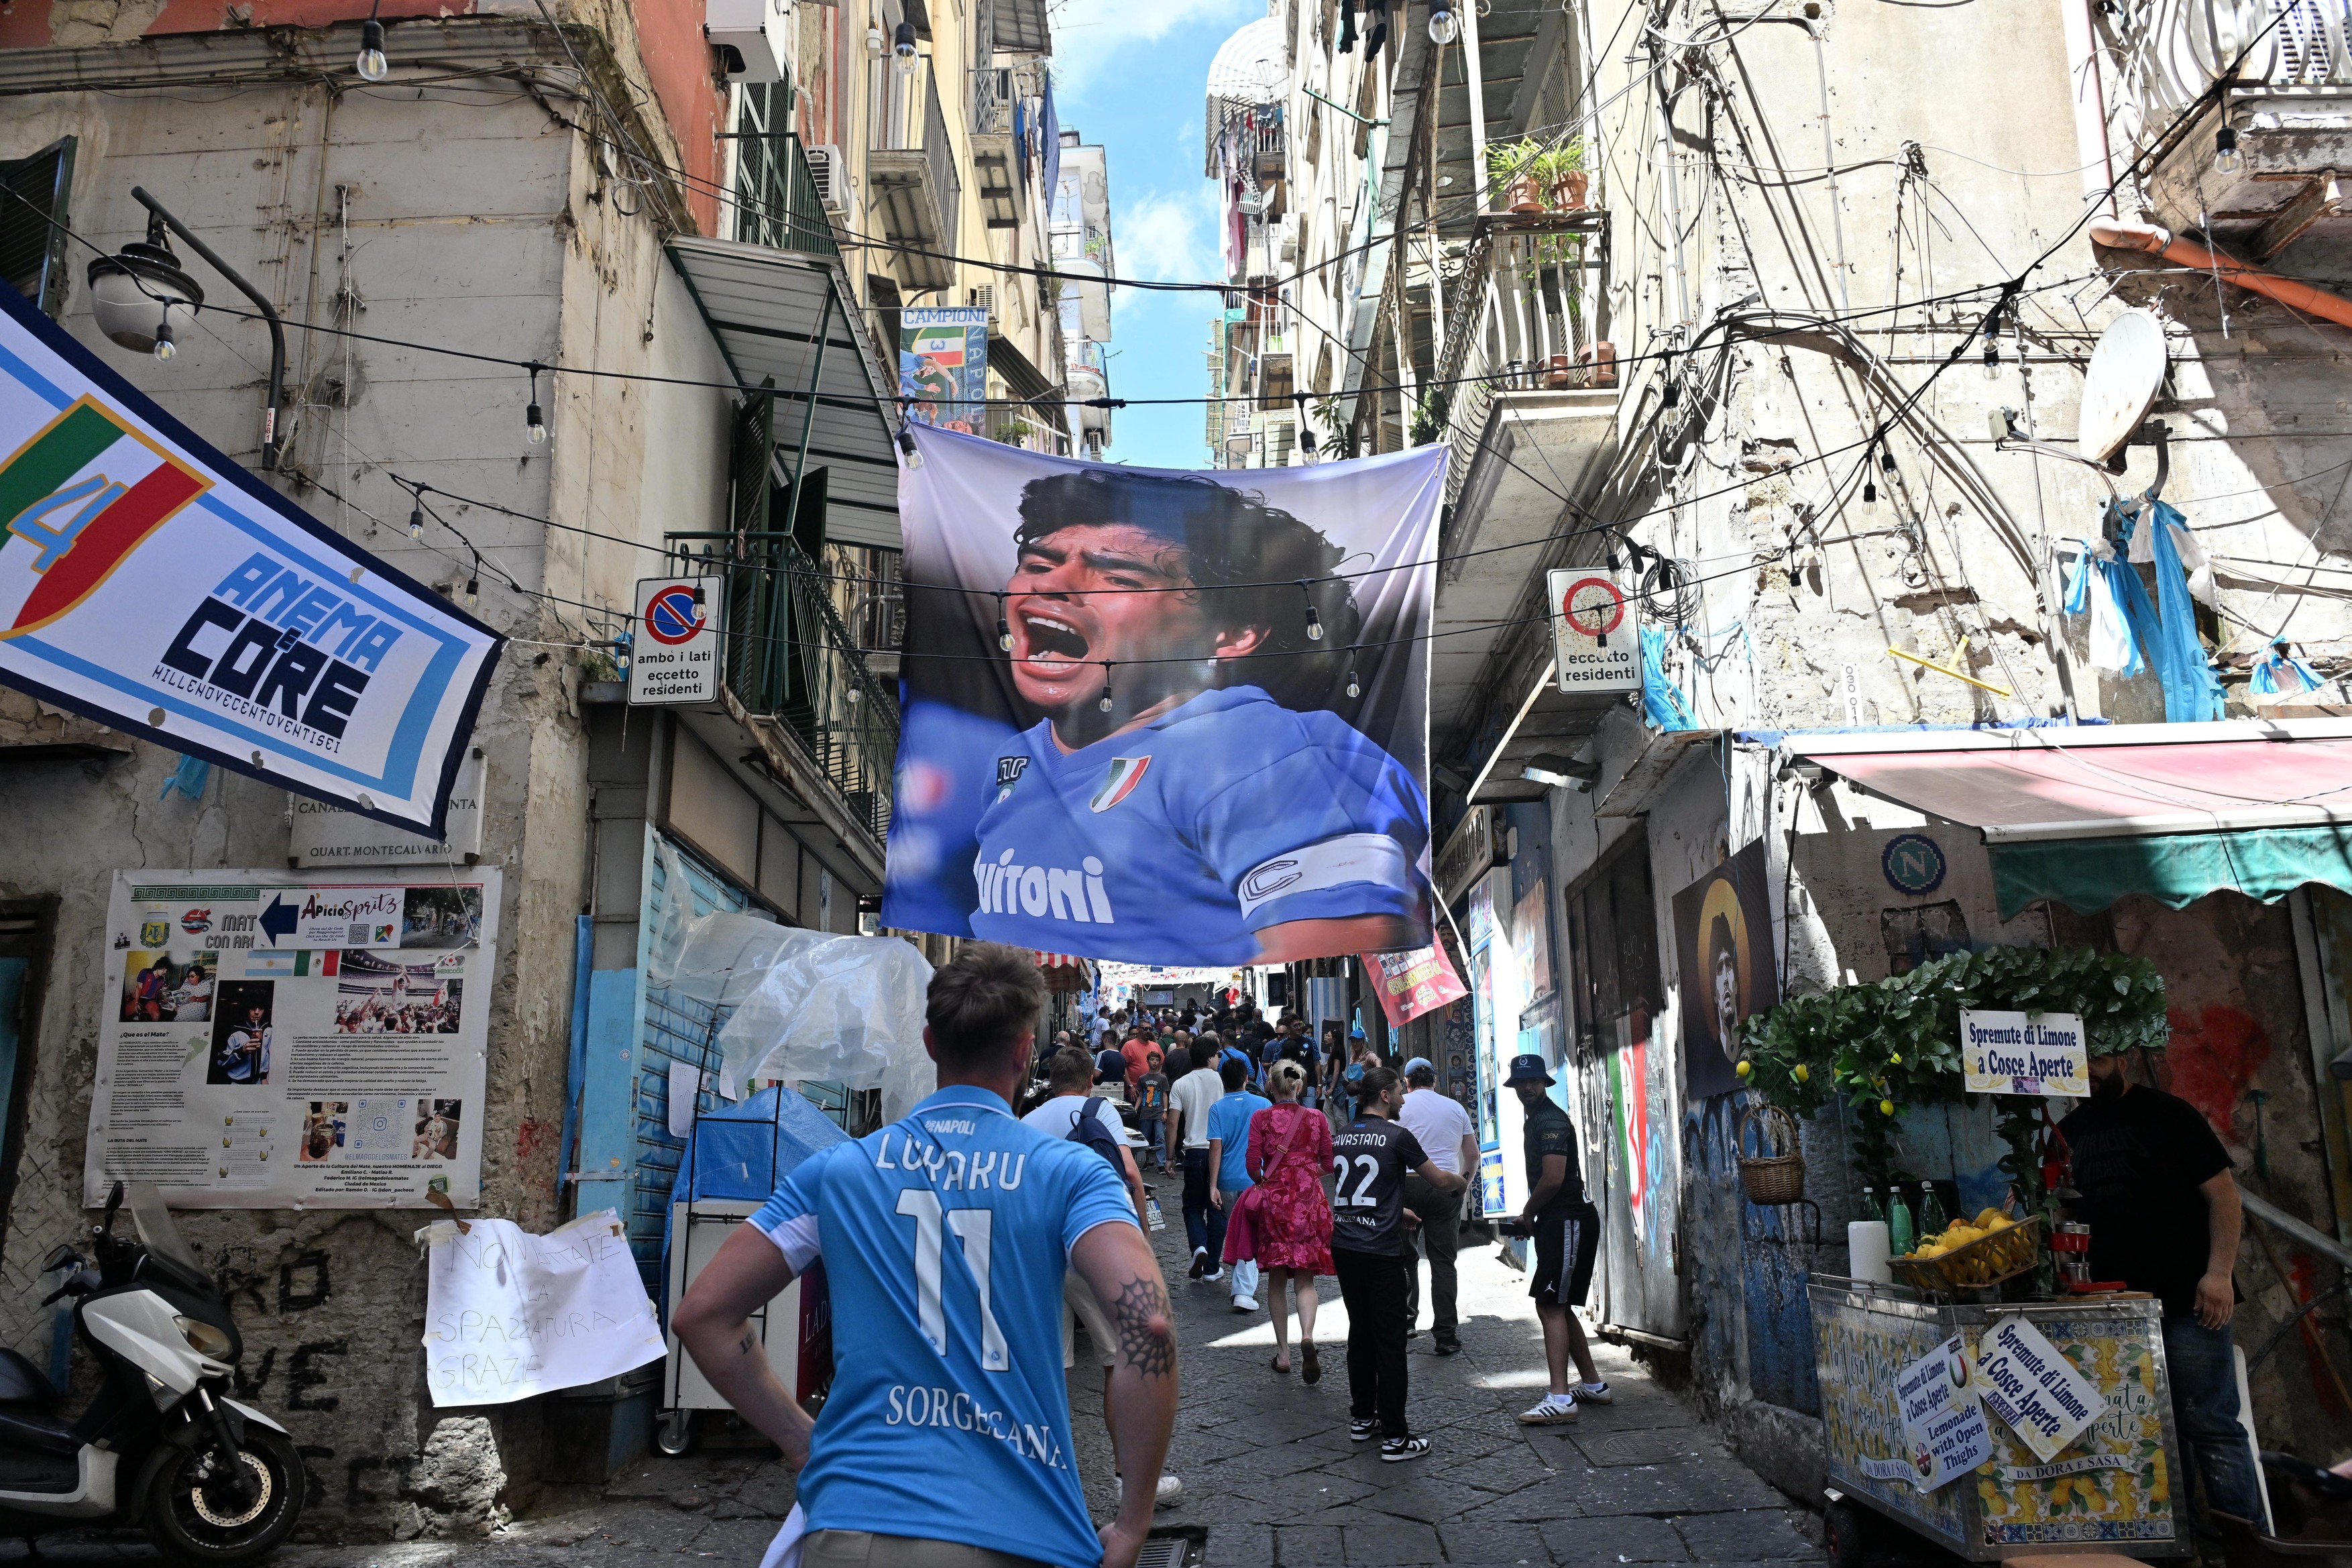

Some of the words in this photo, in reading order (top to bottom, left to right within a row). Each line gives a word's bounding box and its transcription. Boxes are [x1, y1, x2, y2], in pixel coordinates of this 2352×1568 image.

[904, 309, 986, 324] CAMPIONI
[931, 339, 946, 351] 3
[7, 472, 130, 575] 4
[213, 551, 404, 673] ANEMA
[160, 596, 371, 739] CORE
[638, 653, 675, 664] ambo
[680, 651, 683, 662] i
[689, 651, 711, 662] lati
[648, 669, 699, 680] eccetto
[1566, 667, 1635, 681] residenti
[643, 683, 702, 695] residenti
[152, 665, 341, 754] MILLENOVECENTOVENTISEI
[311, 847, 351, 857] QUART.
[353, 844, 452, 856] MONTECALVARIO
[1902, 851, 1927, 877] N
[221, 914, 257, 931] MAT
[205, 935, 229, 948] CON
[1970, 1022, 2021, 1048] Spremute
[2025, 1025, 2035, 1045] di
[2037, 1025, 2076, 1046] Limone
[1978, 1056, 1985, 1074] a
[1989, 1050, 2024, 1076] Cosce
[2029, 1051, 2073, 1082] Aperte
[934, 1120, 976, 1135] NAPOLI
[1333, 1133, 1386, 1147] AVASTANO
[1333, 1154, 1379, 1207] 22
[1334, 1213, 1376, 1227] ORGESANA
[451, 1232, 526, 1272] NON
[895, 1188, 1010, 1371] 11
[528, 1284, 549, 1302] LA
[438, 1310, 616, 1343] SPAZZATURA
[435, 1353, 542, 1389] GRAZIE
[1898, 1377, 1921, 1400] Spremute
[1921, 1373, 1926, 1385] di
[1925, 1359, 1946, 1382] Limone
[1997, 1324, 2046, 1376] Spremute
[2039, 1369, 2058, 1388] di
[2049, 1378, 2089, 1421] Limone
[1906, 1408, 1911, 1422] a
[1910, 1398, 1927, 1418] Cosce
[1927, 1383, 1950, 1410] Aperte
[1978, 1351, 1993, 1367] a
[1987, 1357, 2023, 1398] Cosce
[2015, 1388, 2061, 1438] Aperte
[1991, 1394, 2018, 1420] AVANTI
[1927, 1405, 1977, 1441] Lemonade
[1931, 1437, 1955, 1458] with
[1956, 1422, 1984, 1446] Open
[1874, 1463, 1891, 1477] DORA
[1944, 1445, 1978, 1471] Thighs
[2017, 1470, 2031, 1479] DA
[2036, 1463, 2073, 1476] DORA
